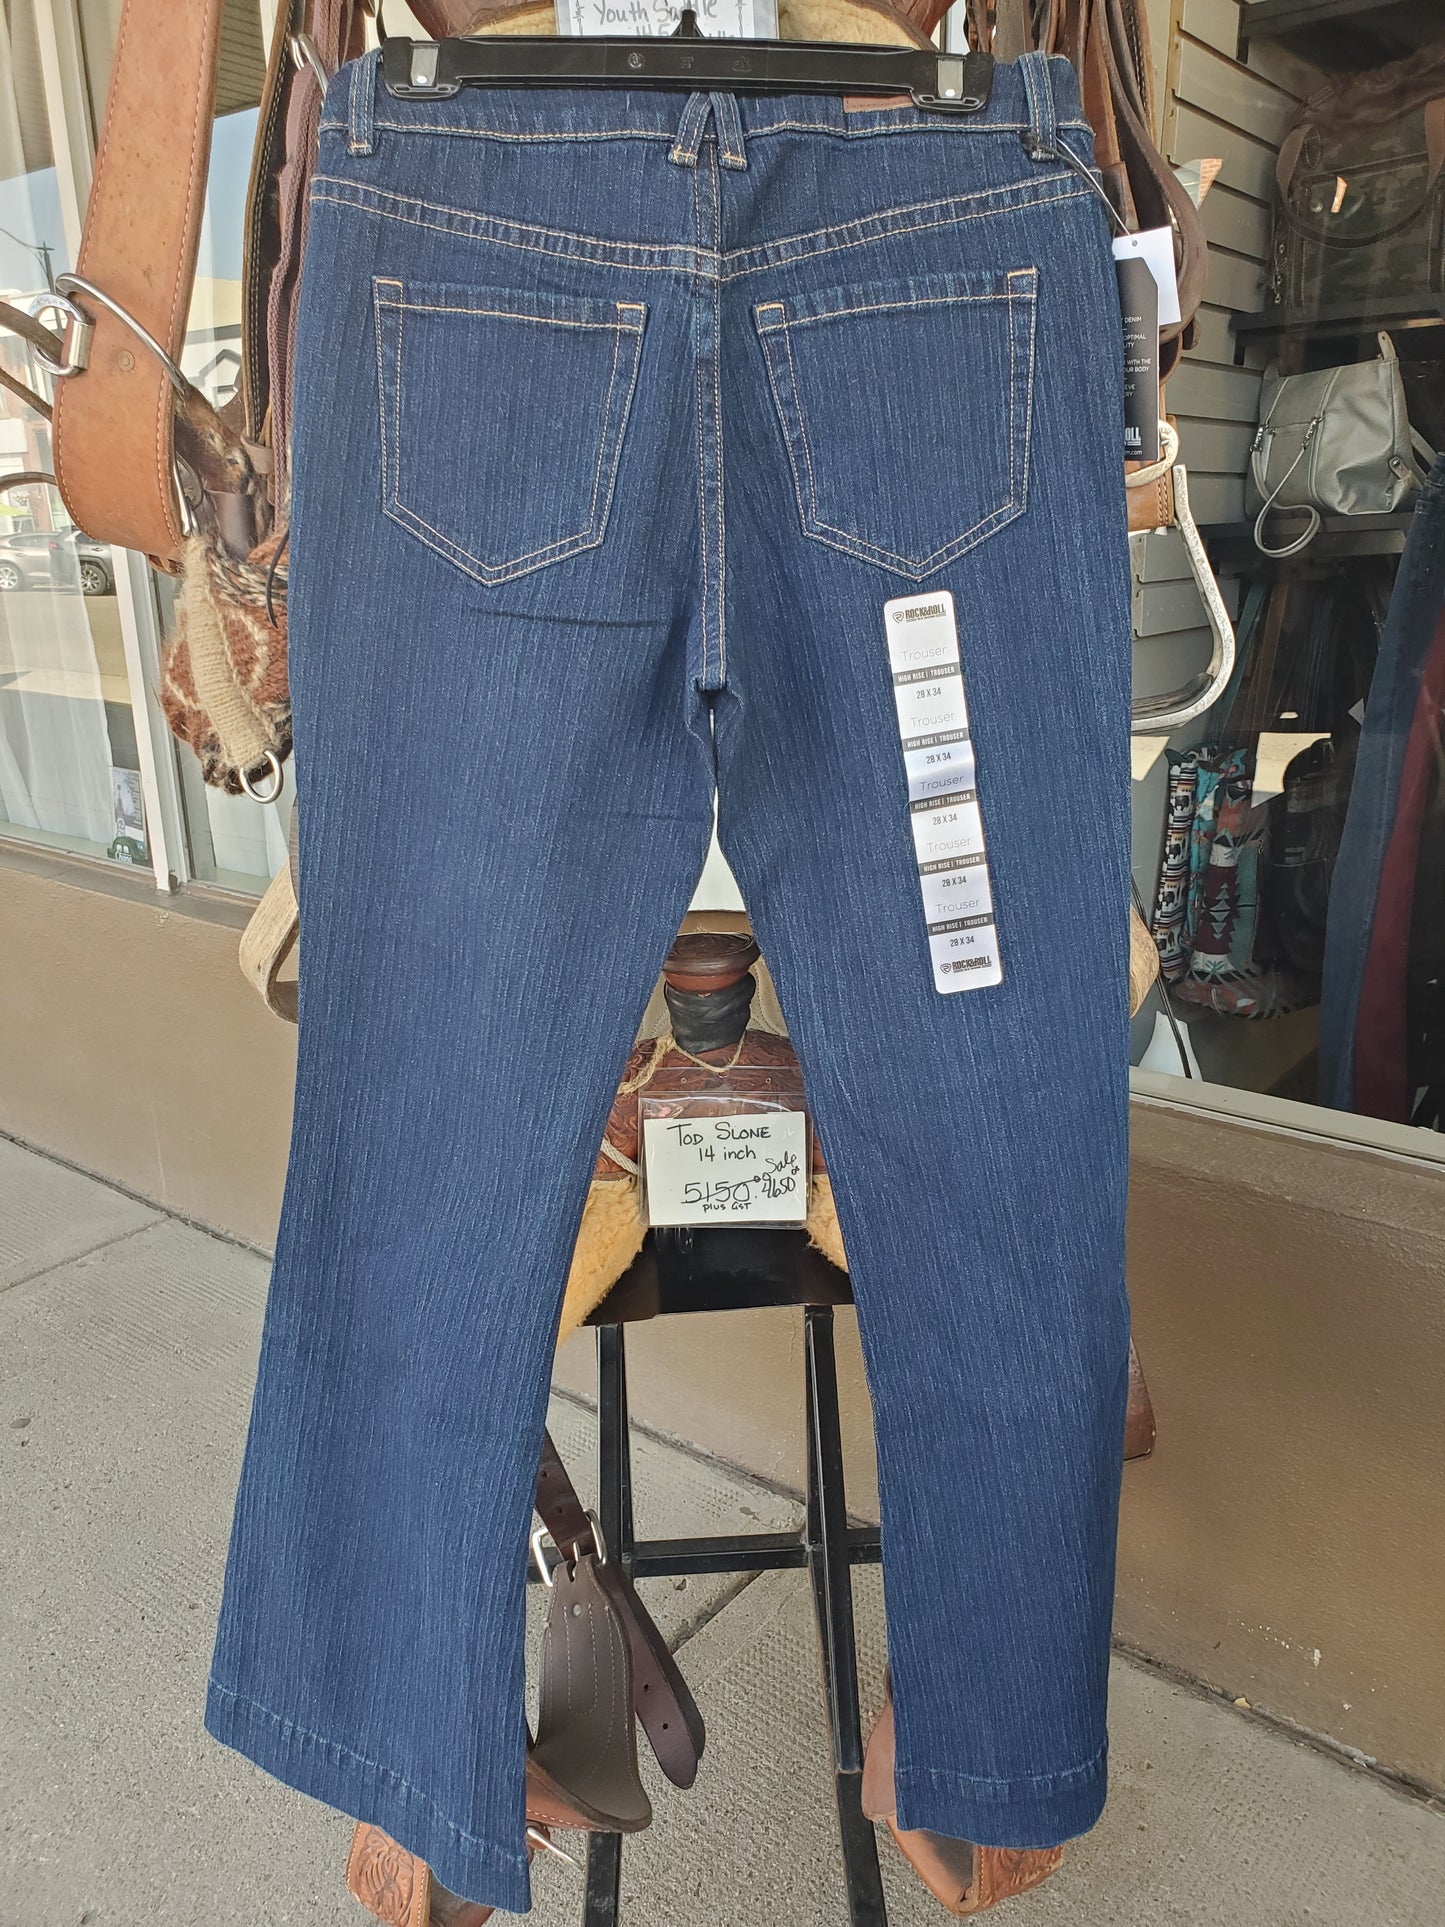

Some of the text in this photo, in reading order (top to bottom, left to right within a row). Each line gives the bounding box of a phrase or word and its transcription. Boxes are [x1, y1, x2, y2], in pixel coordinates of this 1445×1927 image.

[593, 0, 649, 25] Youth
[901, 647, 947, 662] Trouser
[930, 666, 955, 677] TROUSER
[916, 689, 926, 699] 28
[932, 687, 941, 697] 34
[910, 713, 955, 728] Trouser
[939, 731, 964, 742] TROUSER
[926, 755, 935, 764] 28
[942, 751, 951, 761] 34
[920, 776, 964, 791] Trouser
[946, 793, 971, 803] TROUSER
[932, 816, 942, 825] 28
[948, 813, 957, 822] 34
[927, 837, 971, 854] Trouser
[955, 856, 980, 866] TROUSER
[941, 878, 951, 888] 28
[957, 875, 967, 884] 34
[935, 899, 980, 914] Trouser
[963, 916, 988, 927] TROUSER
[949, 938, 959, 947] 28
[966, 935, 975, 945] 34
[715, 1121, 771, 1140] SLONE
[699, 1145, 756, 1162] 14 inch
[765, 1151, 797, 1174] Sale
[702, 1201, 752, 1213] plus GST
